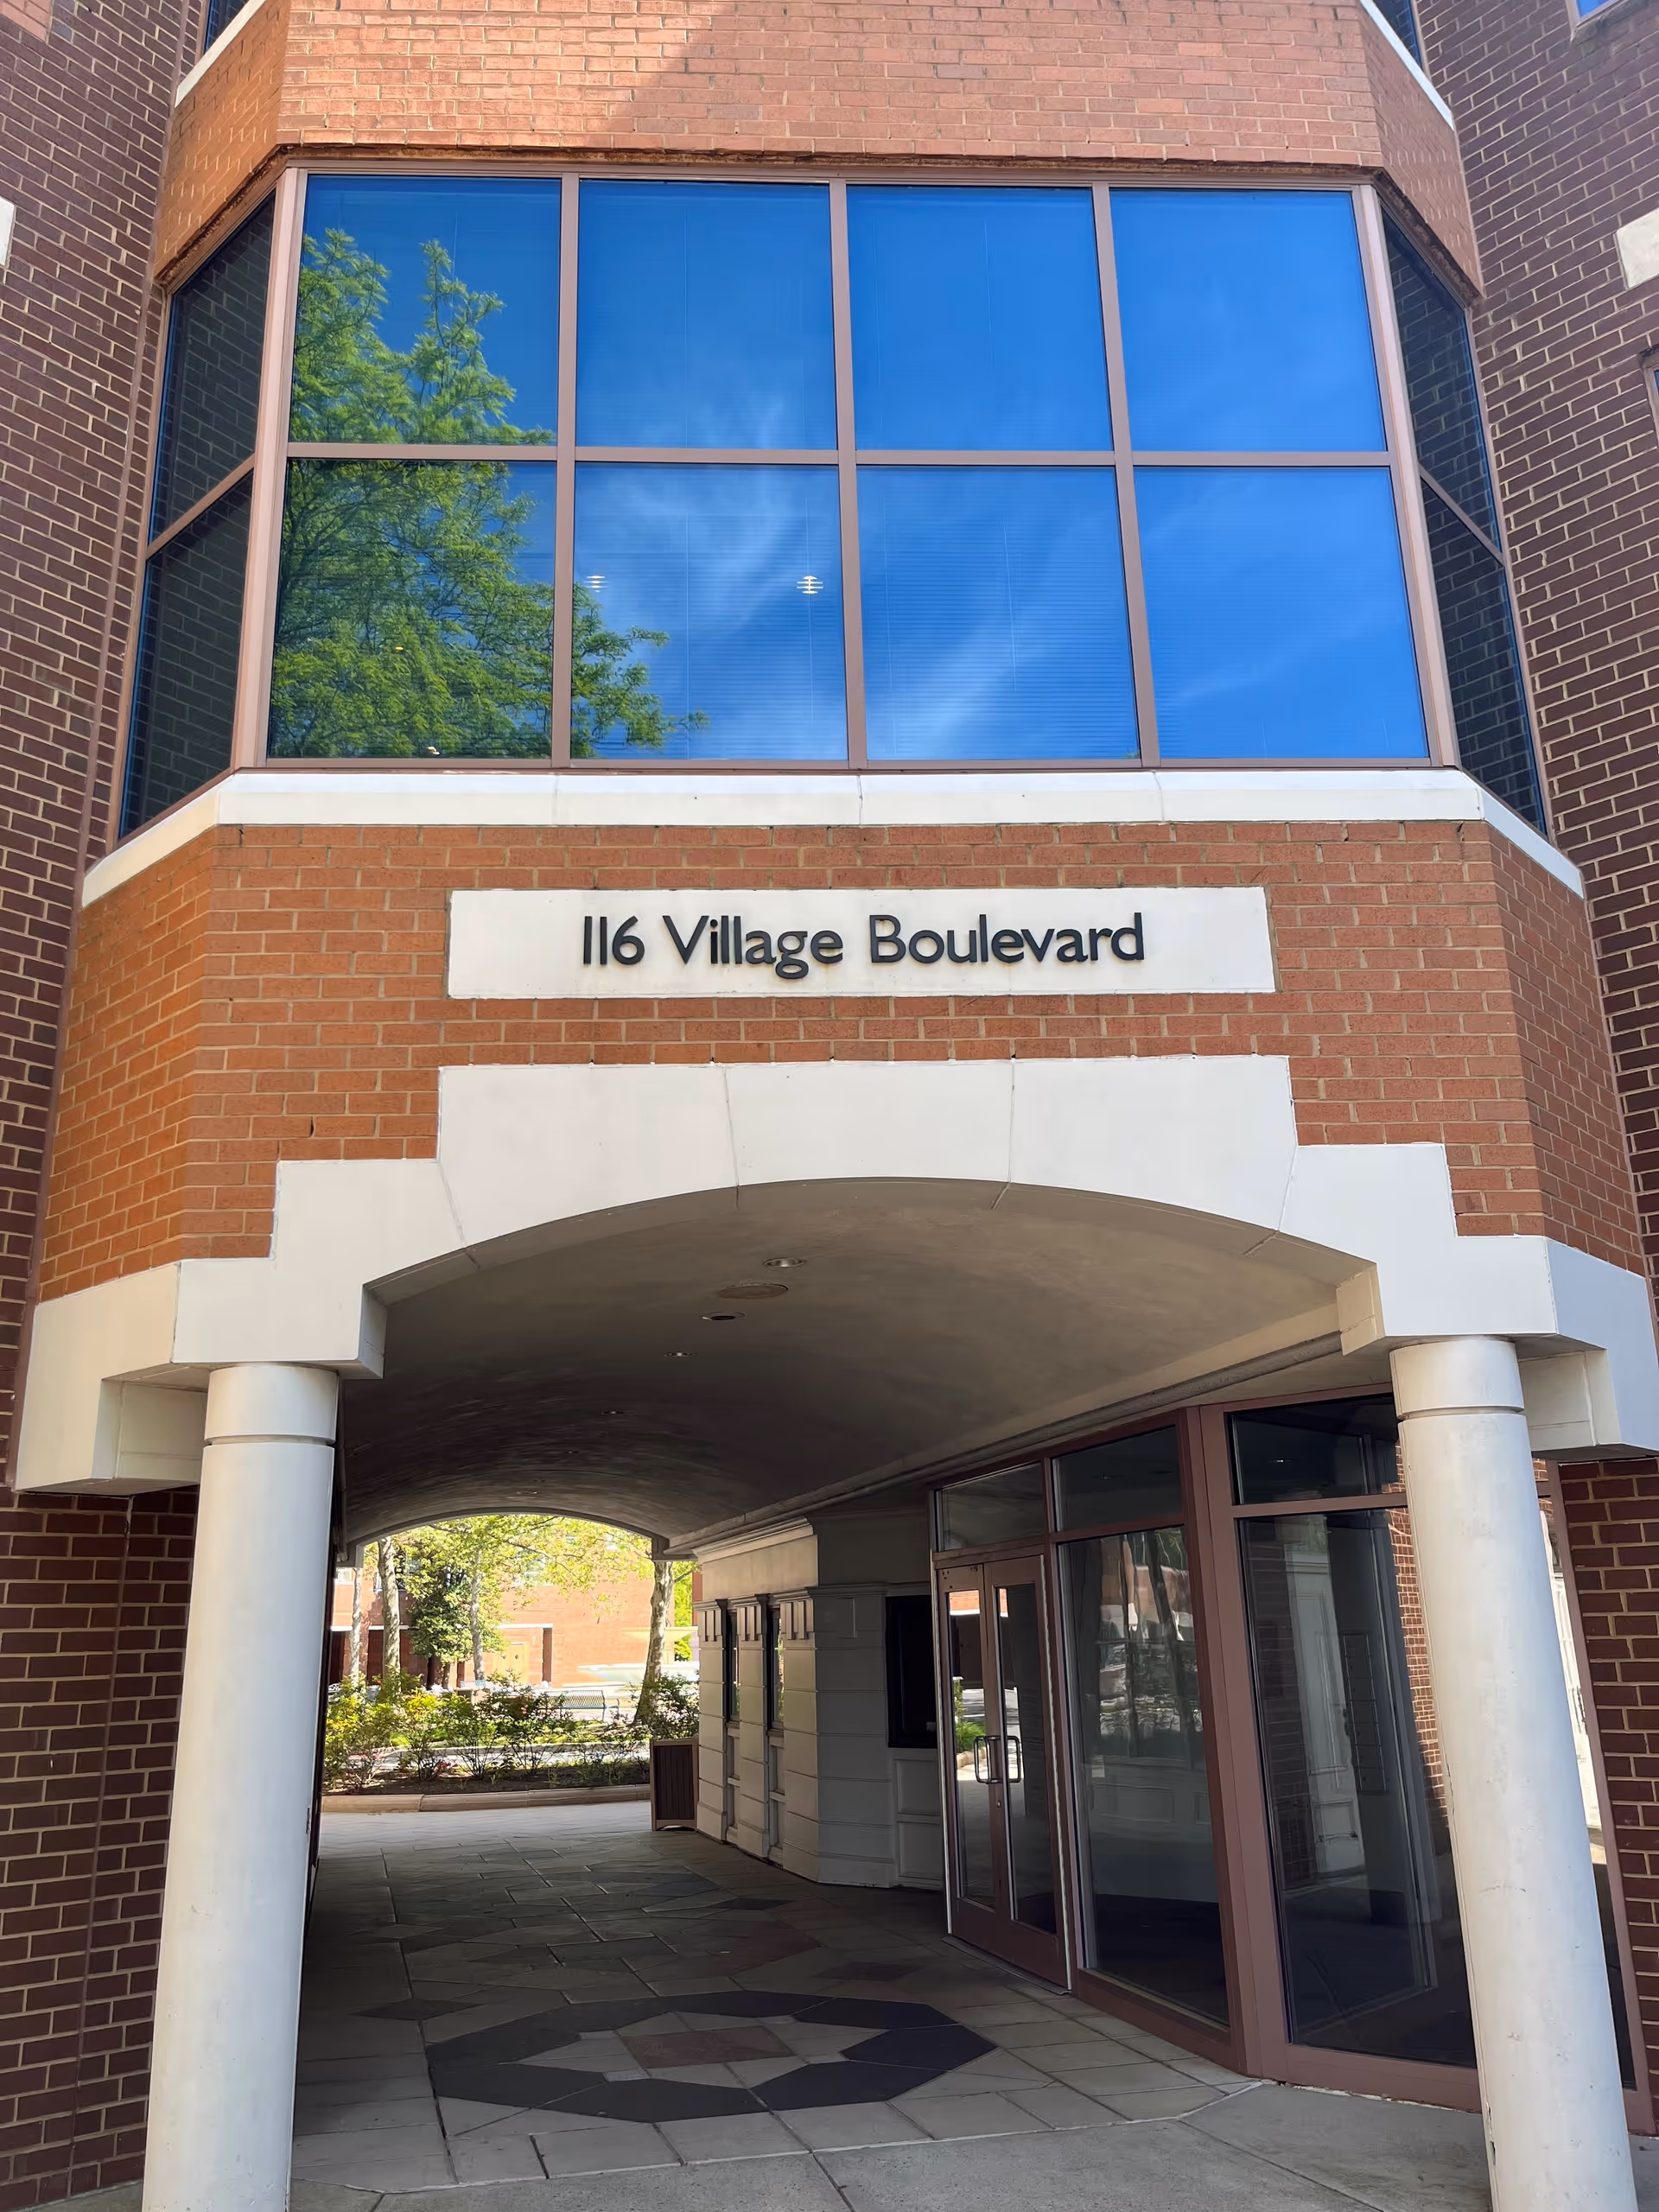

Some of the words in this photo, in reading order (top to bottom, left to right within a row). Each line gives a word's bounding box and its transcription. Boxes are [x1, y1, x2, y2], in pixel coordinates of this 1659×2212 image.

[582, 915, 645, 966] 116
[662, 914, 843, 981] Village
[869, 912, 1145, 965] Boulevard
